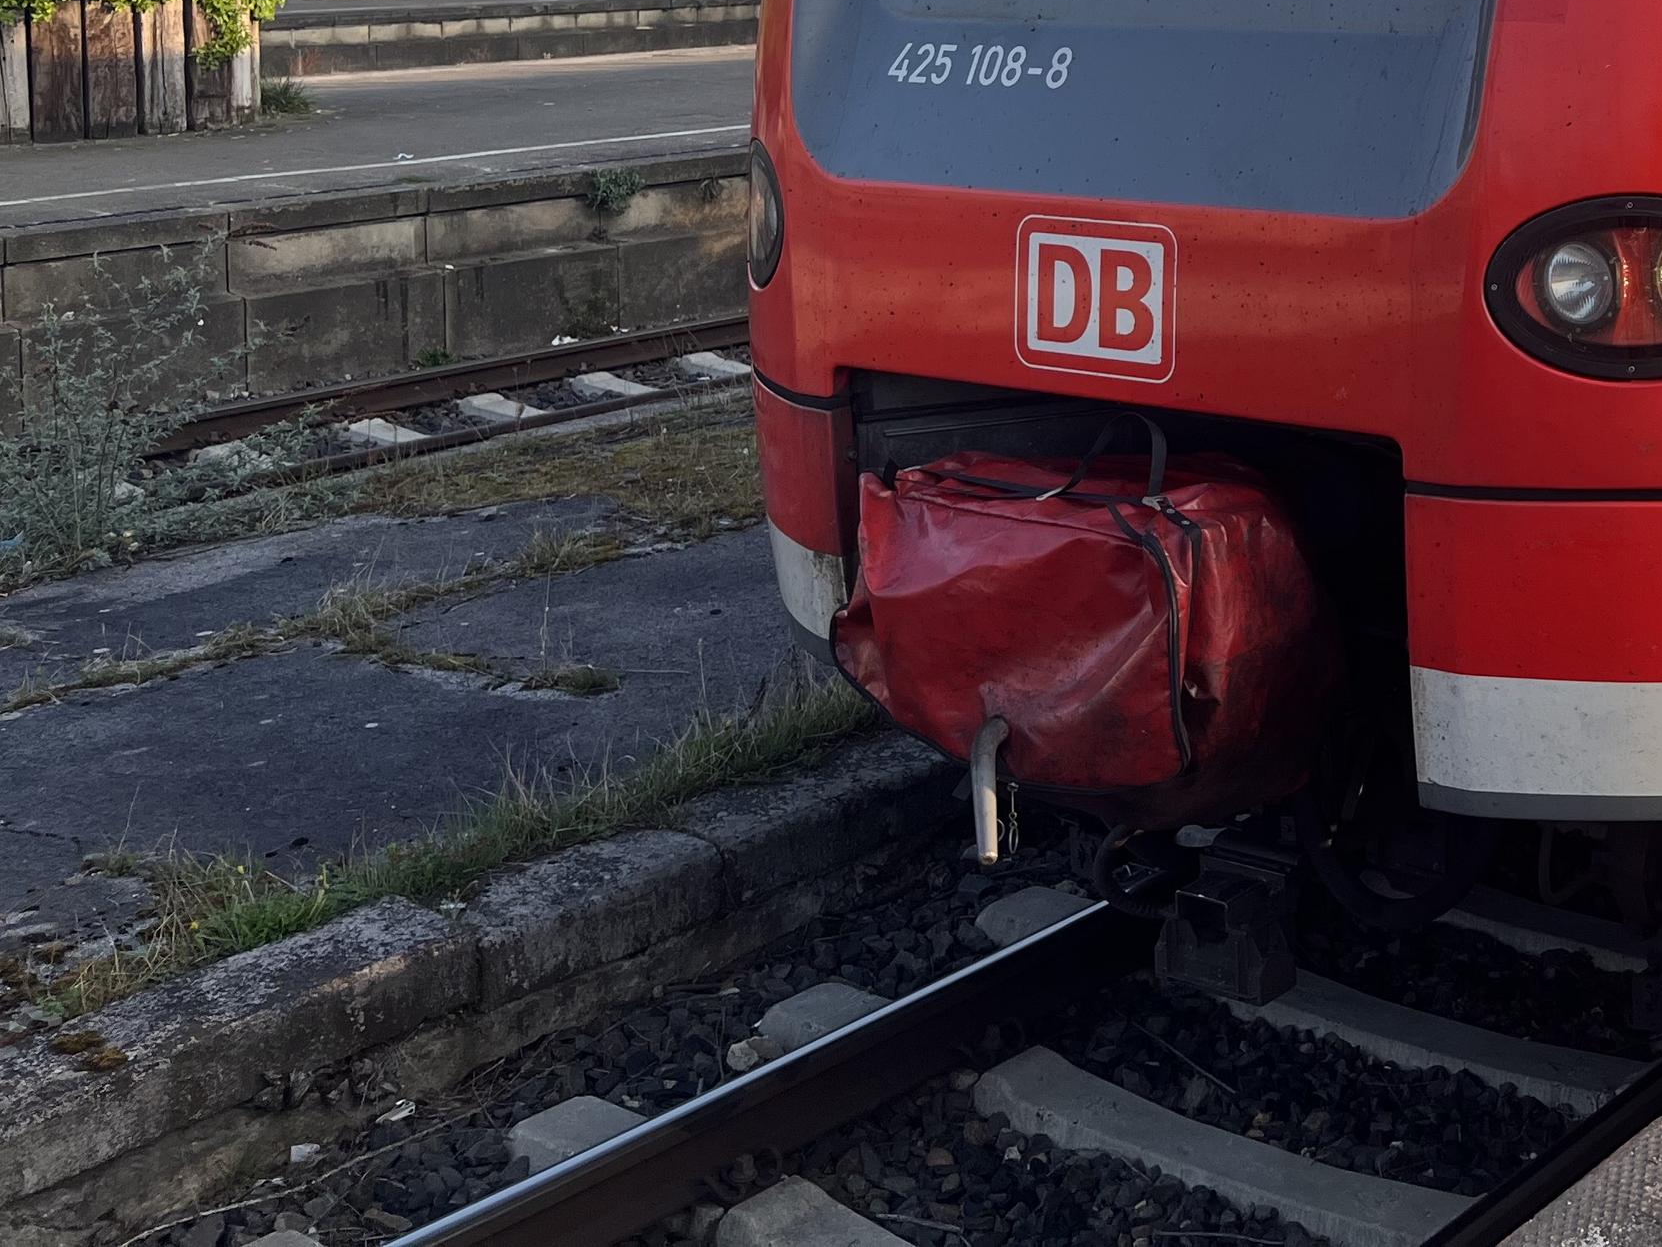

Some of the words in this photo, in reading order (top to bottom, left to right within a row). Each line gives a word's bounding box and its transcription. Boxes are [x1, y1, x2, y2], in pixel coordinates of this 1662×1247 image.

[888, 42, 957, 85] 425
[966, 45, 1072, 89] 108-8
[1037, 242, 1155, 352] DB
